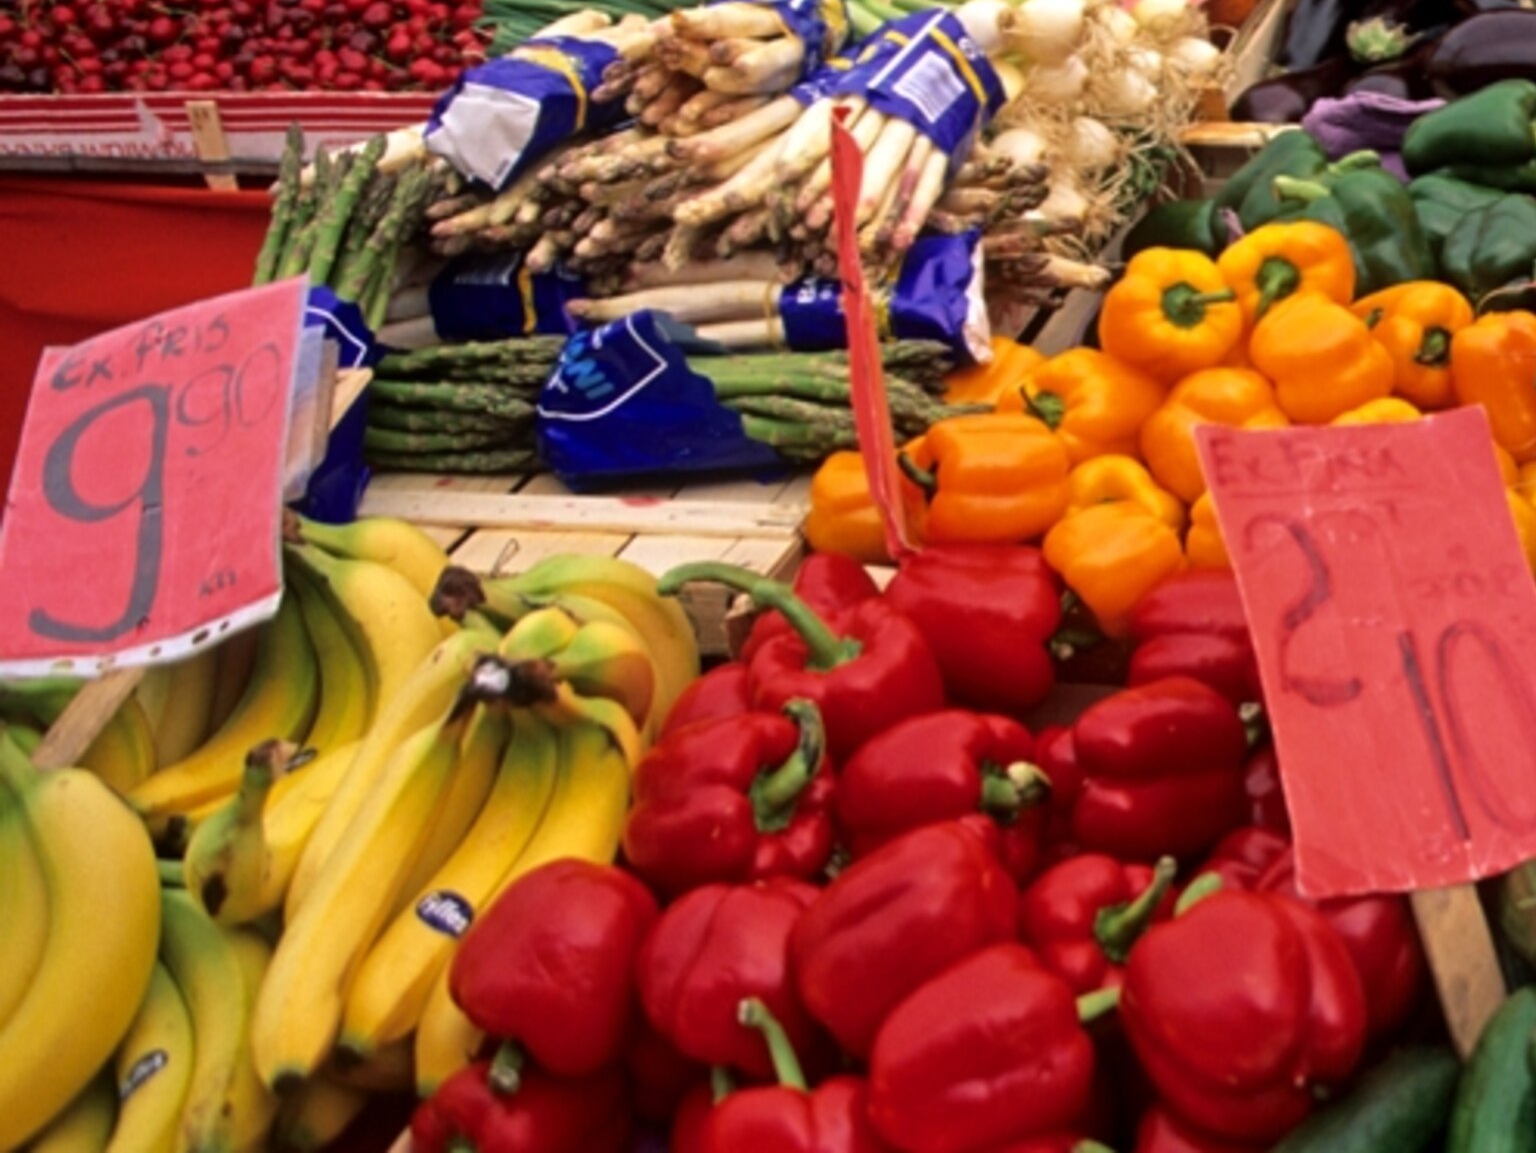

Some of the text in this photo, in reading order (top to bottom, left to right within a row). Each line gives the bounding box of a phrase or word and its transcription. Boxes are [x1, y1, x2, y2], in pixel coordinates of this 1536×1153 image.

[27, 343, 282, 644] 9 90
[1243, 510, 1364, 708] 2
